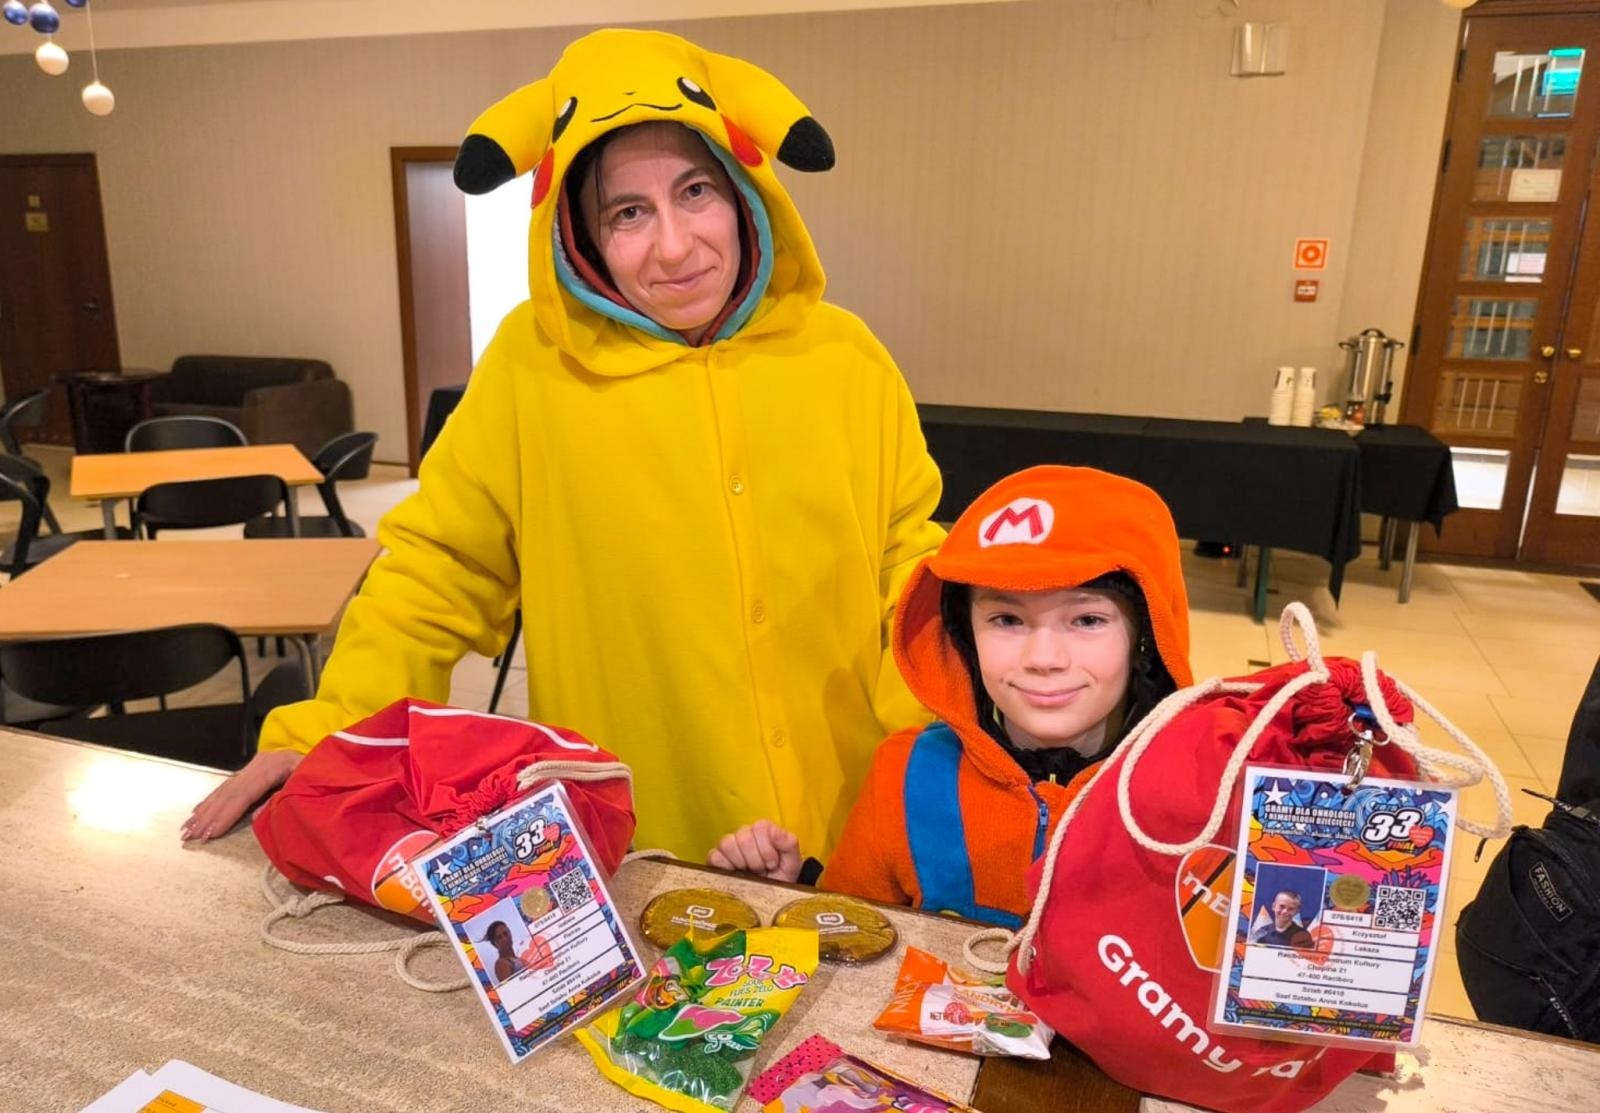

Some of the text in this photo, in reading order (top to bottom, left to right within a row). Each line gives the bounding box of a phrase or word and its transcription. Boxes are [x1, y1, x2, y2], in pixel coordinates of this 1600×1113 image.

[984, 504, 1044, 541] M
[1265, 804, 1294, 815] GRAMY
[1363, 808, 1422, 843] 33
[514, 816, 547, 859] 33
[1530, 866, 1569, 914] FASHION
[715, 997, 764, 1008] PAINTER
[1097, 934, 1243, 1073] Gramy
